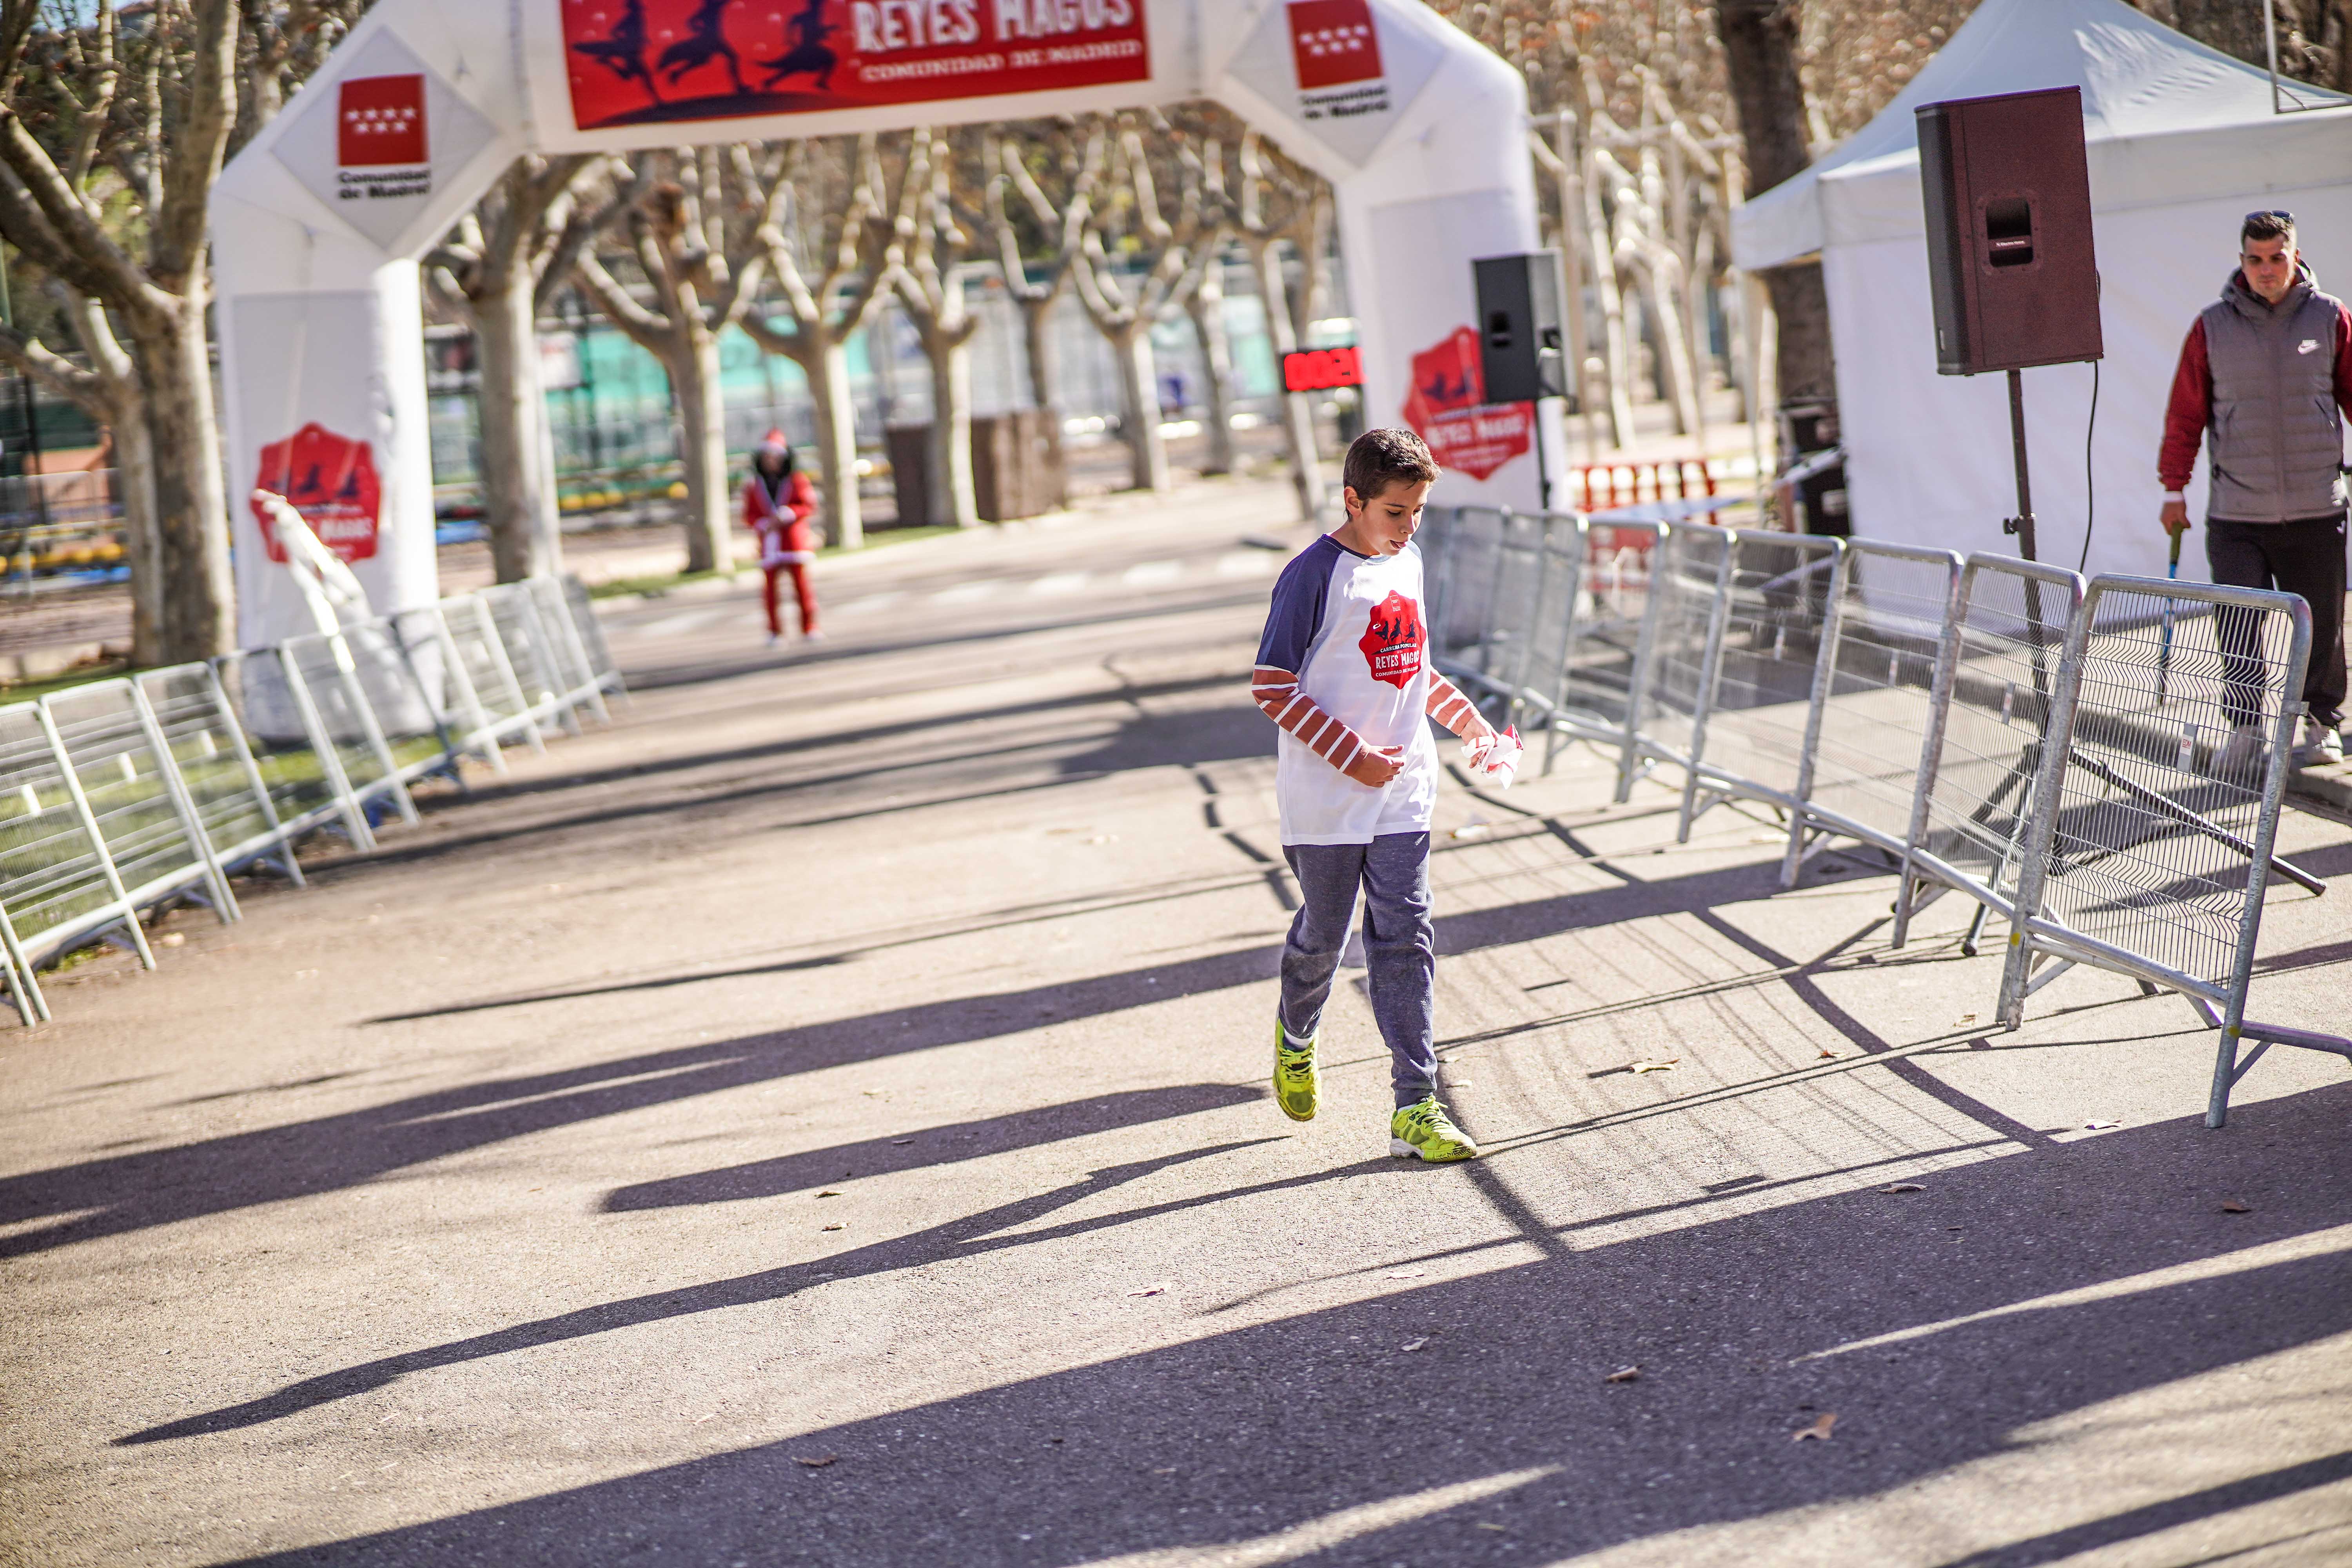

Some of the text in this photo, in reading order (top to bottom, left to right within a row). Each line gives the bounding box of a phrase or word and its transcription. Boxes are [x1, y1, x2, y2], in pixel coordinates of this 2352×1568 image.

[853, 0, 1133, 53] REYES MAGOS
[860, 40, 1142, 82] COMUNIDAD DE MADRID
[1376, 650, 1419, 669] REYES MAGOS
